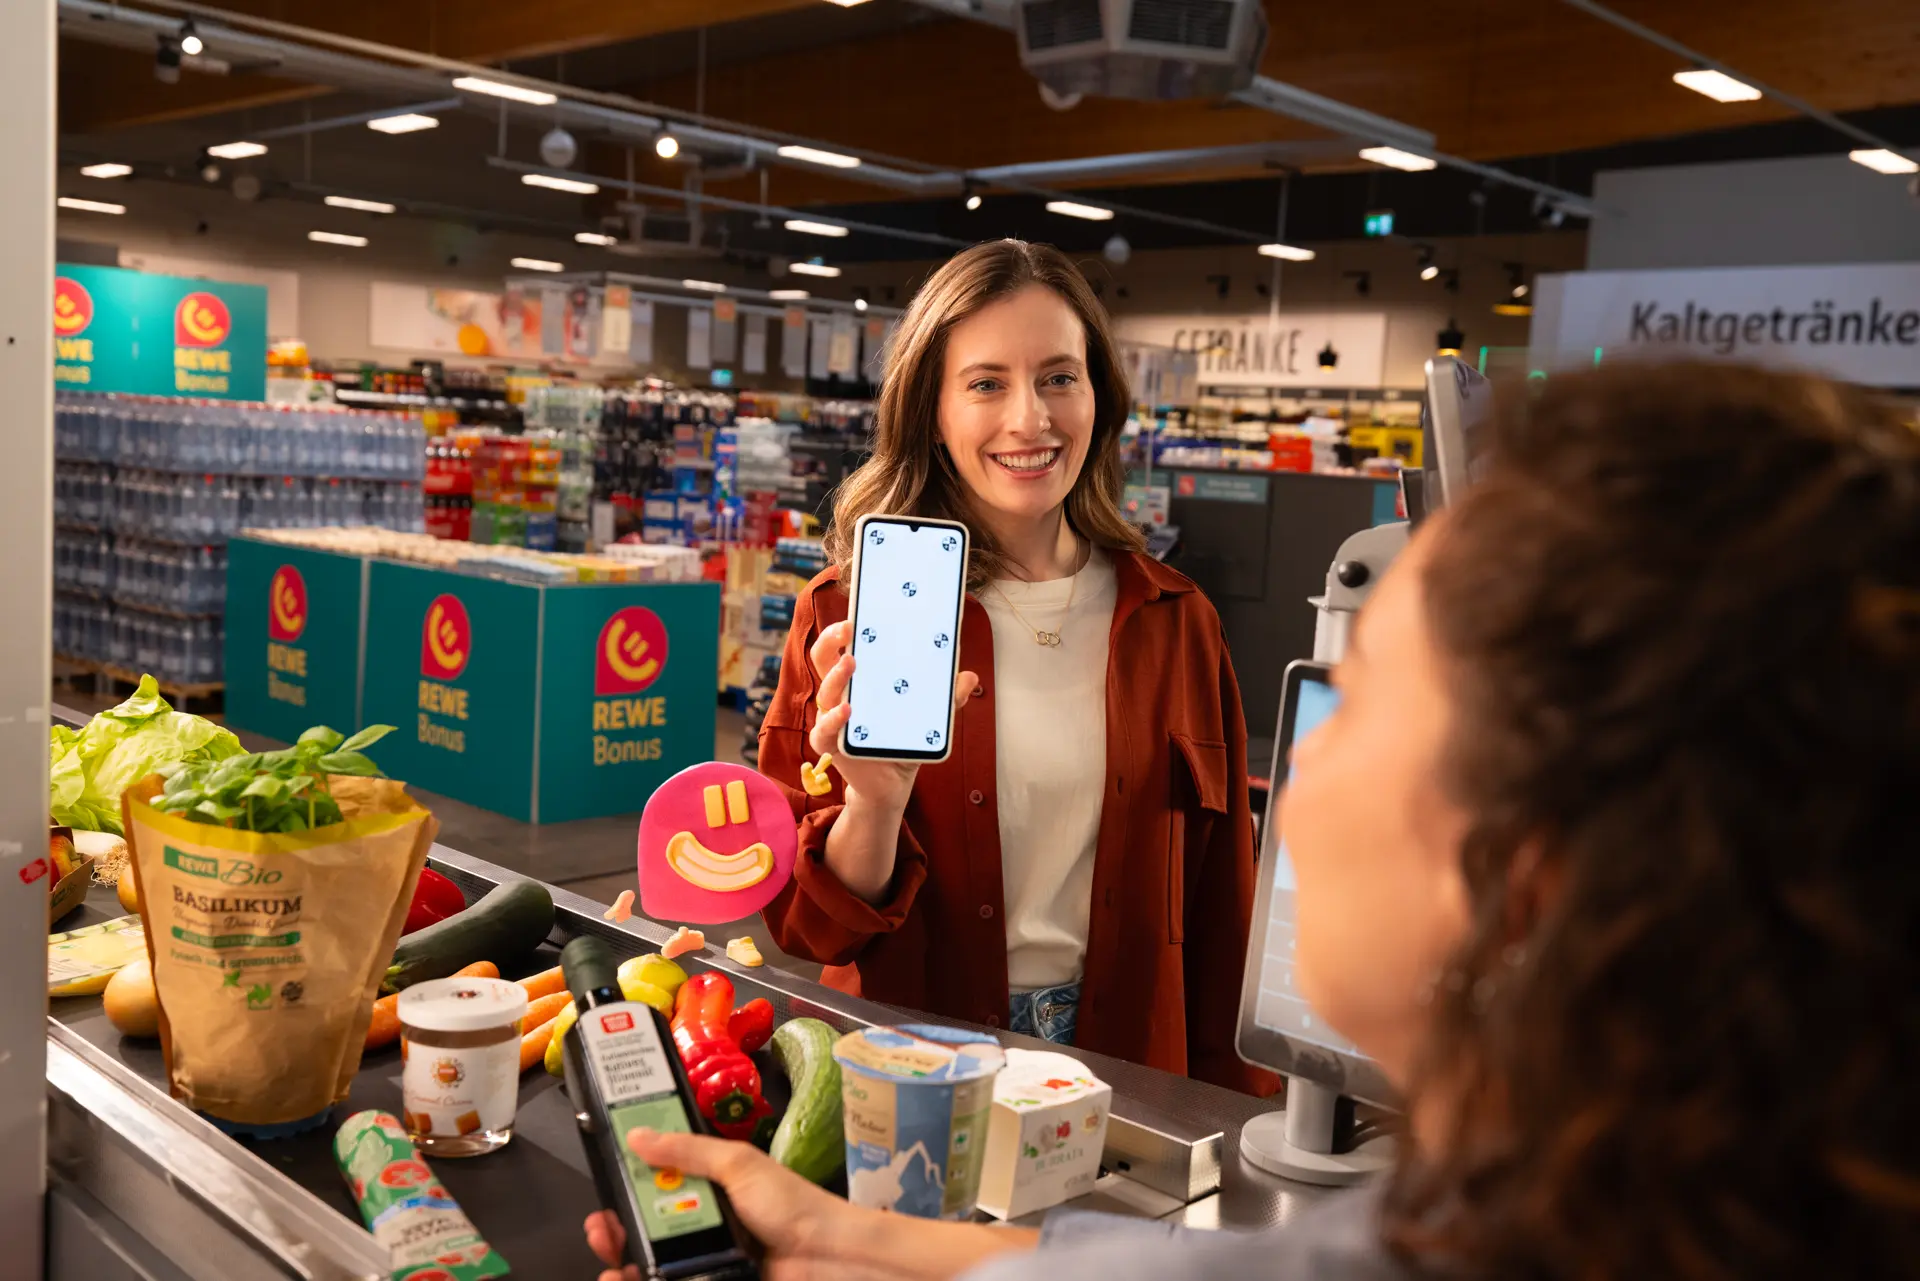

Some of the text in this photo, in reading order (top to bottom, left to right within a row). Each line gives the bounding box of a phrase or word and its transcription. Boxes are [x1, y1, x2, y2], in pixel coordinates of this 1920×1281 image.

[1631, 298, 1920, 353] Kaltgetränke
[268, 642, 308, 678] REWE
[268, 671, 306, 707] Bonus
[418, 680, 469, 720] REWE
[592, 696, 667, 731] REWE
[418, 712, 465, 753] Bonus
[593, 735, 662, 766] Bonus
[219, 858, 283, 886] Bio
[172, 884, 303, 915] BASILIKUM
